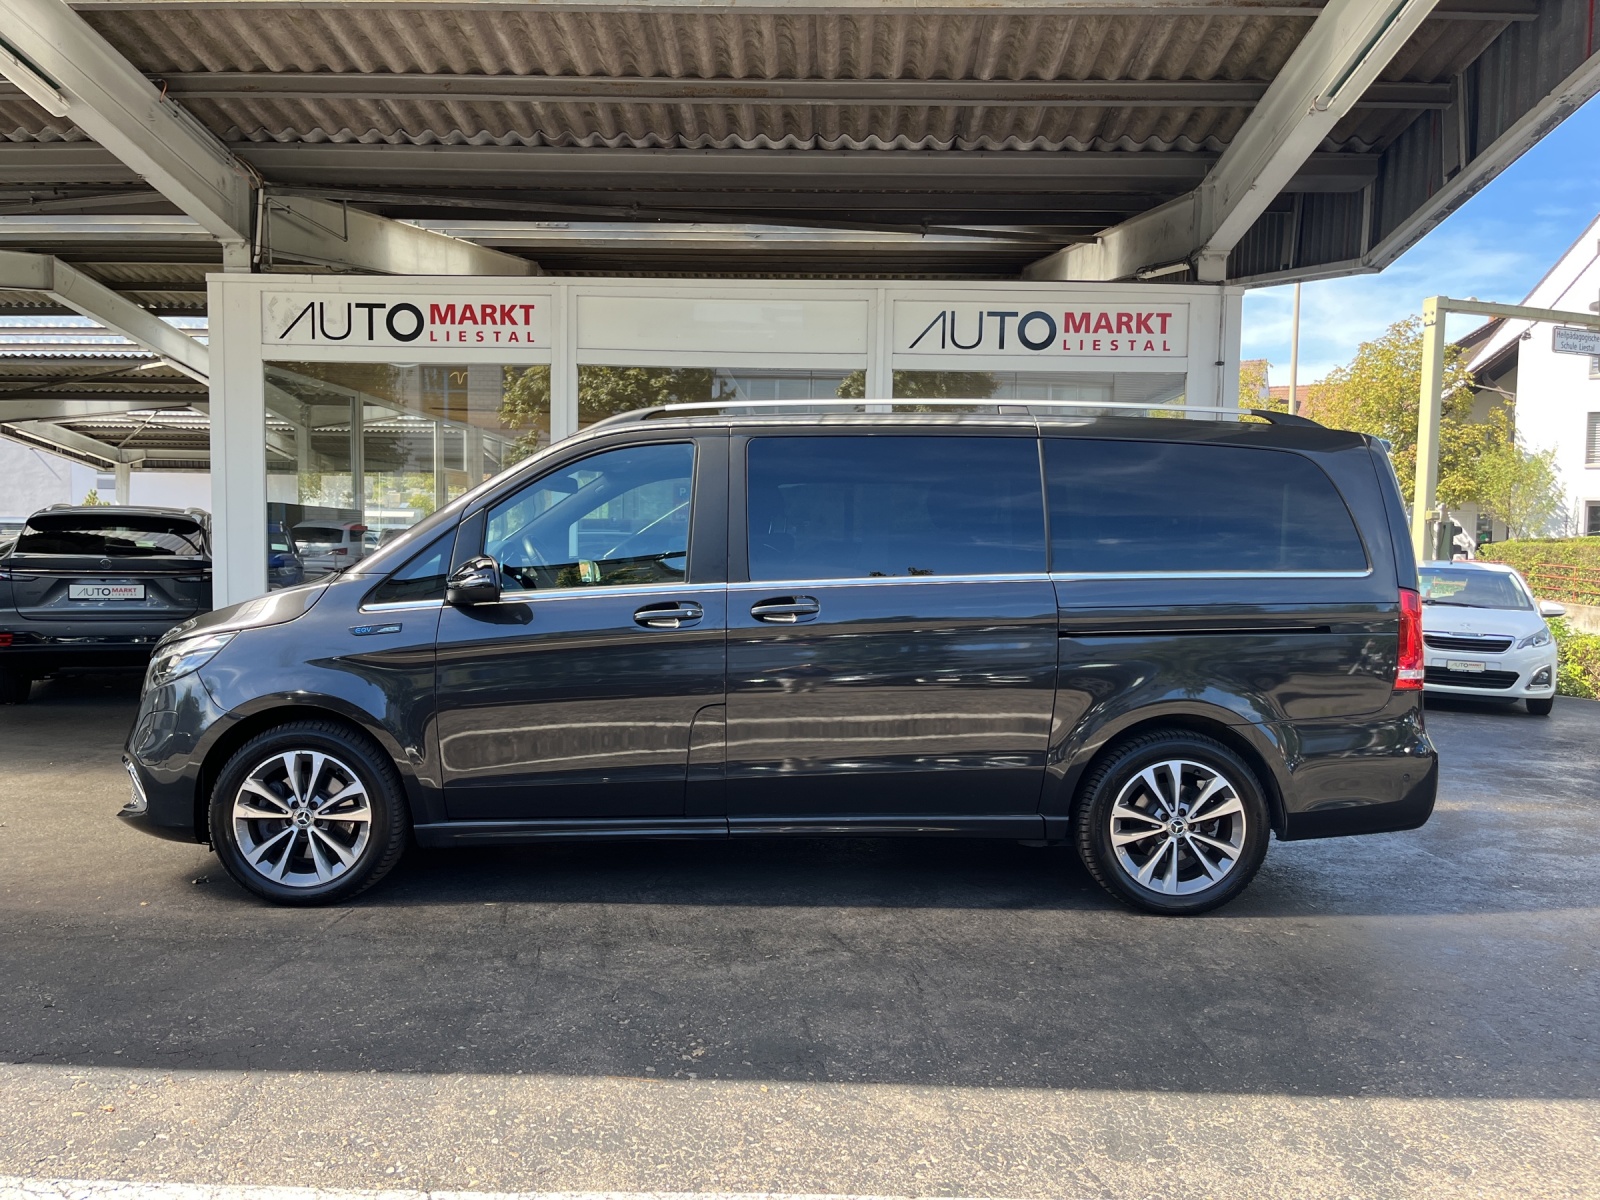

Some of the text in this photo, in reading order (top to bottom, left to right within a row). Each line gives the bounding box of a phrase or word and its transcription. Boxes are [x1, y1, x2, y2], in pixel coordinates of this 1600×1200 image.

[279, 302, 535, 342] AUTO MARKT
[908, 310, 1172, 351] AUTO MARKT
[430, 331, 535, 343] LIESTAL
[1063, 339, 1171, 351] LIESTAL
[1561, 341, 1595, 352] Schule Liestal
[77, 588, 111, 596] AUTO
